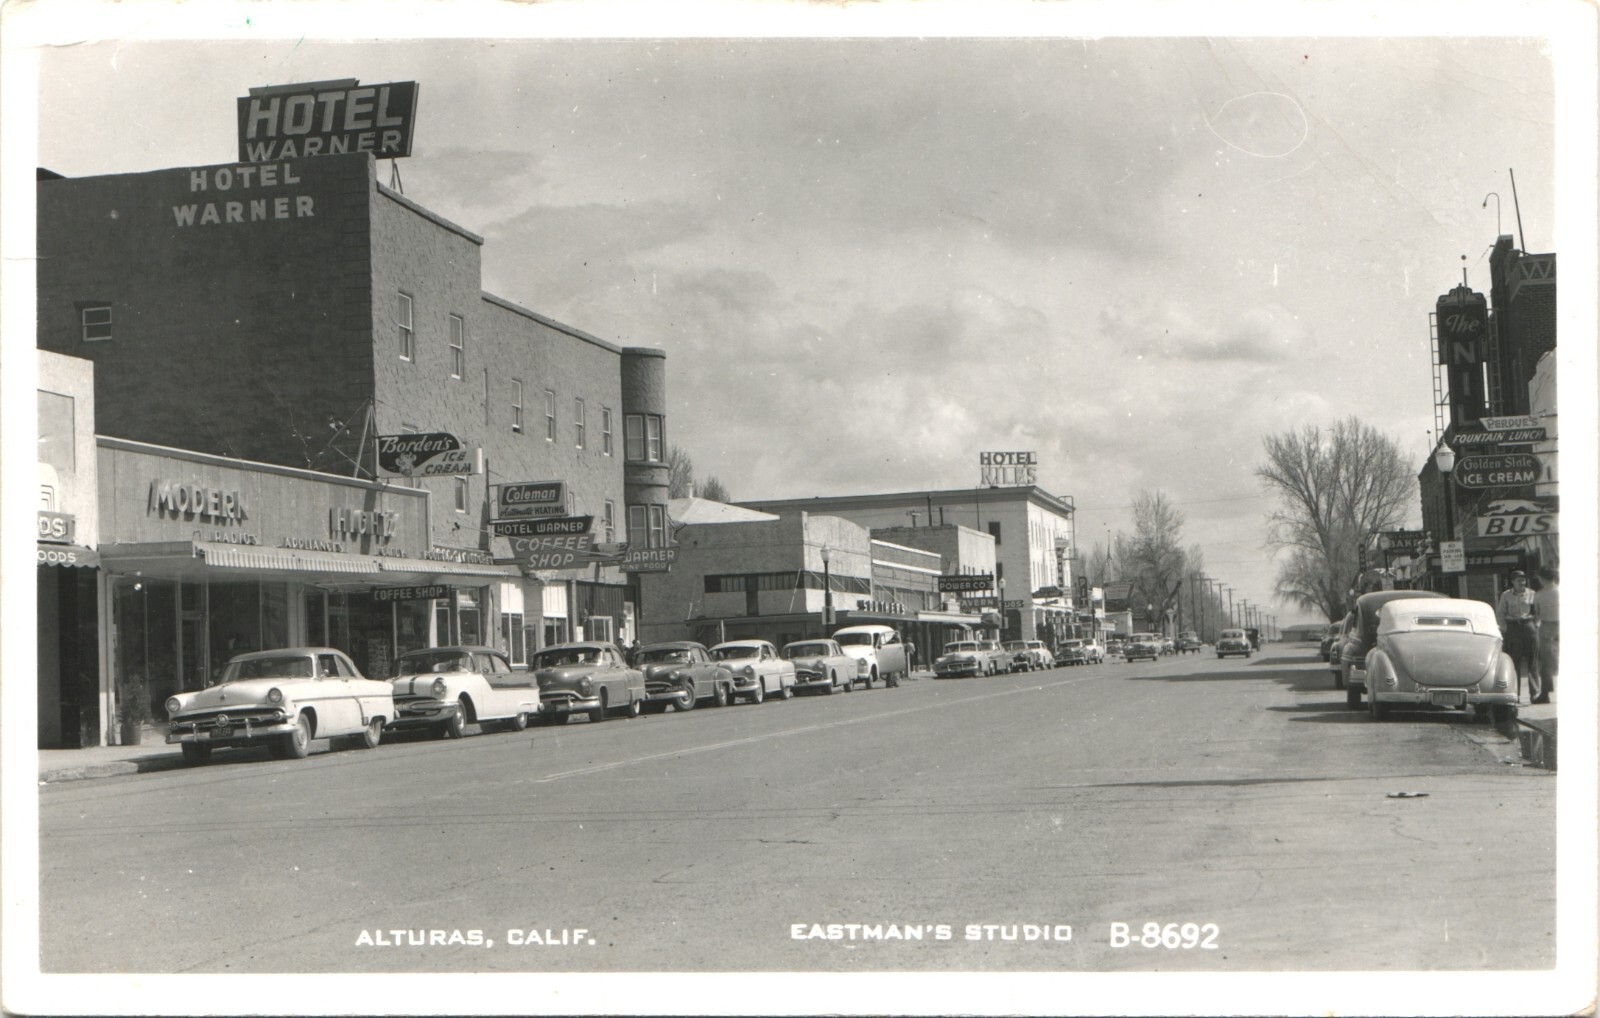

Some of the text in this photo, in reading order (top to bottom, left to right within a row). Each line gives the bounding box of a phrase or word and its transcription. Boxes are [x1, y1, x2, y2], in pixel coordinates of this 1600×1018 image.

[246, 87, 403, 139] HOTEL
[246, 130, 402, 162] WARNER
[190, 162, 301, 192] HOTEL
[172, 196, 315, 227] WARNER
[1445, 314, 1480, 334] The
[379, 435, 453, 453] Borden's
[1452, 430, 1545, 444] FOUNTAIN LUNCH
[442, 451, 467, 462] ICE
[980, 451, 1038, 465] HOTEL
[425, 463, 472, 474] CREAM
[1463, 458, 1501, 470] Golden
[981, 467, 1037, 484] NILES
[1463, 471, 1535, 485] ICE CREAM
[506, 486, 556, 503] Coleman
[534, 505, 565, 515] HEATING
[497, 522, 584, 534] HOTEL WARNER
[1485, 515, 1554, 535] BUS
[515, 536, 589, 552] COFFEE
[528, 554, 575, 568] SHOP
[939, 581, 971, 590] POWER
[374, 587, 443, 601] COFFEE SHOP
[959, 598, 994, 607] AVERN
